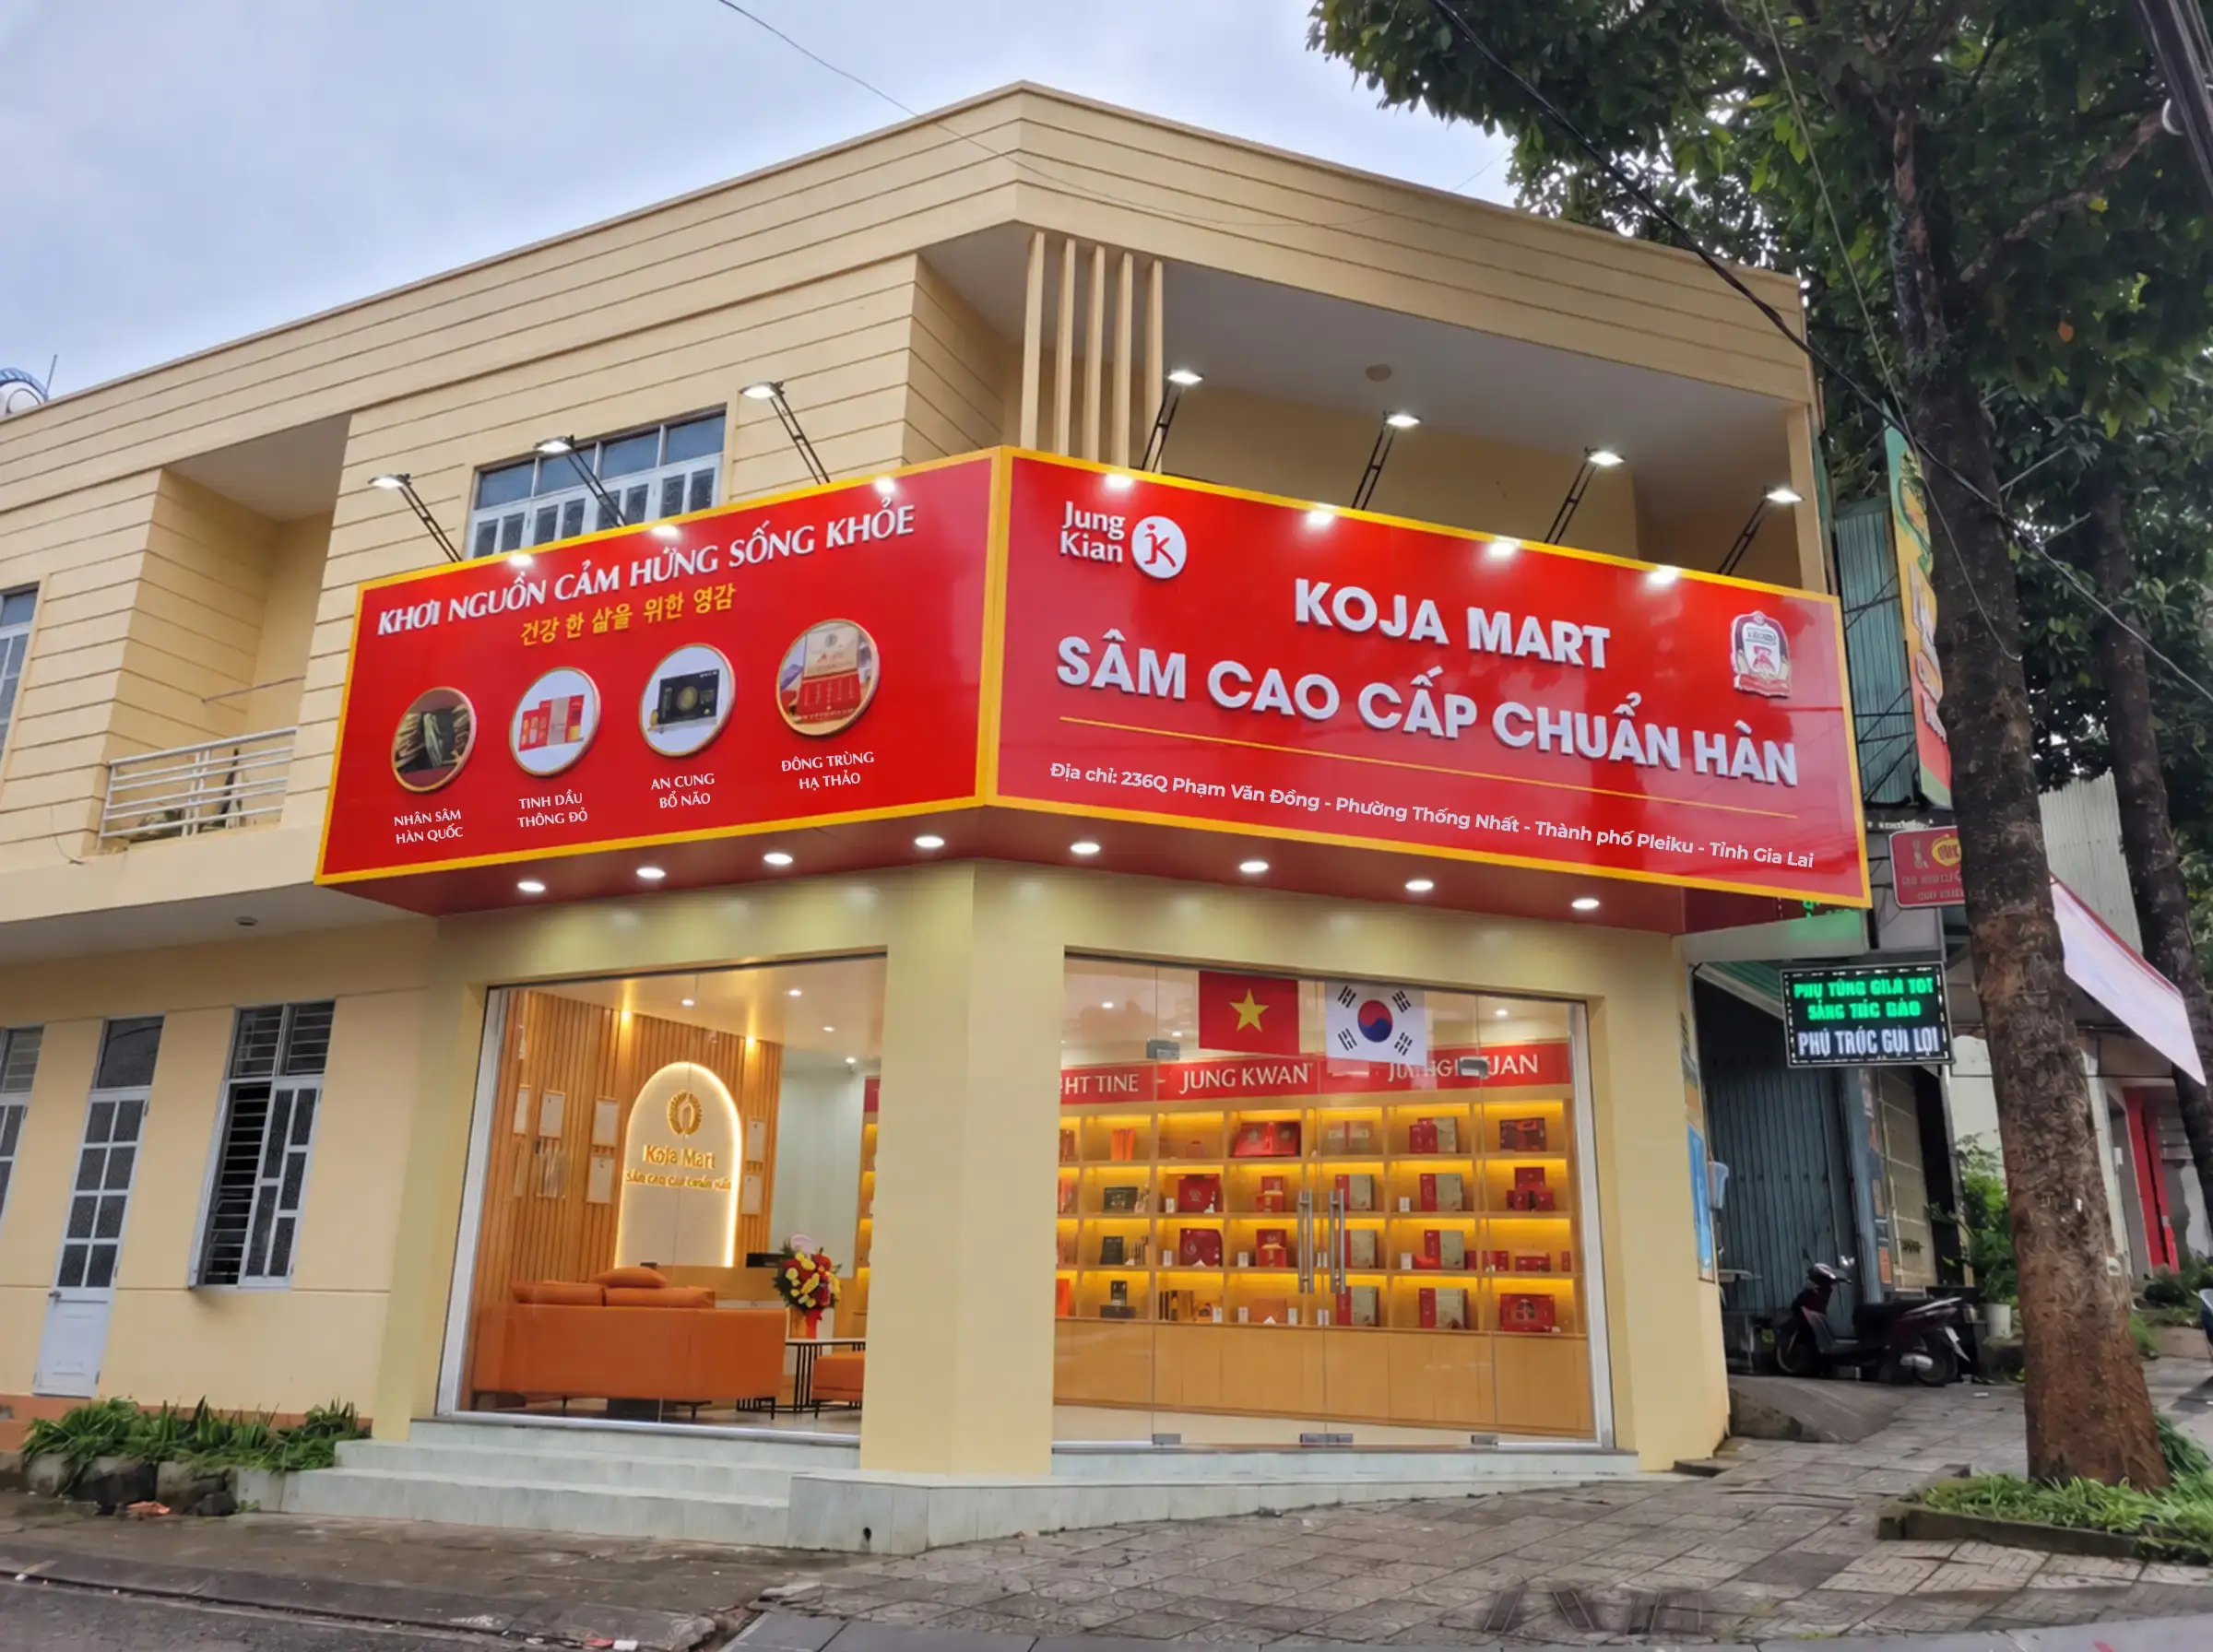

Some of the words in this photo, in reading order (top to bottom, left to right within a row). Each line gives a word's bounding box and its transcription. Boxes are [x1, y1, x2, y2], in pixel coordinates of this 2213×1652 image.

[1062, 501, 1125, 540] Jung
[1059, 531, 1123, 563] Kian
[377, 599, 441, 635] KHƠI
[448, 572, 546, 622] NGUỒN
[555, 560, 620, 600] CẢM
[630, 546, 718, 586] HỨNG
[729, 520, 814, 568] SỐNG
[826, 497, 914, 549] KHỎE
[521, 617, 559, 646] 건강
[566, 612, 585, 639] 한
[592, 603, 633, 634] 삶을
[643, 592, 684, 623] 위한
[693, 583, 736, 614] 영감
[1296, 578, 1449, 645] KOJA
[1466, 606, 1610, 669] MART
[1057, 628, 1187, 701] SÂM
[1207, 660, 1340, 720] CAO
[1358, 665, 1477, 738] CẤP
[1492, 692, 1681, 772] CHUẨN
[1692, 719, 1798, 787] HÀN
[781, 756, 823, 772] ĐÔNG
[826, 750, 875, 768] TRÙNG
[650, 778, 670, 790] AN
[674, 773, 715, 787] CUNG
[799, 777, 820, 792] HẠ
[822, 770, 861, 787] THẢO
[518, 796, 551, 809] TINH
[554, 788, 583, 806] DẦU
[659, 790, 678, 808] BỔ
[680, 791, 711, 807] NÃO
[394, 810, 432, 827] NHÂN
[435, 808, 461, 822] SÂM
[517, 811, 565, 828] THÔNG
[568, 807, 588, 823] ĐỎ
[1050, 762, 1081, 783] Địa
[1085, 767, 1118, 785] chỉ:
[1120, 771, 1168, 794] 236Q
[1173, 777, 1225, 798] Phạm
[1231, 784, 1265, 803] Văn
[1270, 788, 1320, 812] Đồng
[1336, 796, 1407, 822] Phường
[1413, 805, 1470, 830] Thống
[1475, 813, 1520, 833] Nhất
[1535, 820, 1592, 843] Thành
[1597, 829, 1635, 847] phố
[1637, 832, 1693, 855] Pleiku
[1710, 841, 1749, 861] Tỉnh
[1753, 847, 1783, 866] Gia
[1787, 851, 1815, 868] Lai
[396, 828, 424, 844] HÀN
[427, 823, 464, 842] QUỐC
[1095, 1073, 1139, 1092] TINE
[1179, 1067, 1236, 1094] JUNG
[1241, 1062, 1309, 1088] KWAN
